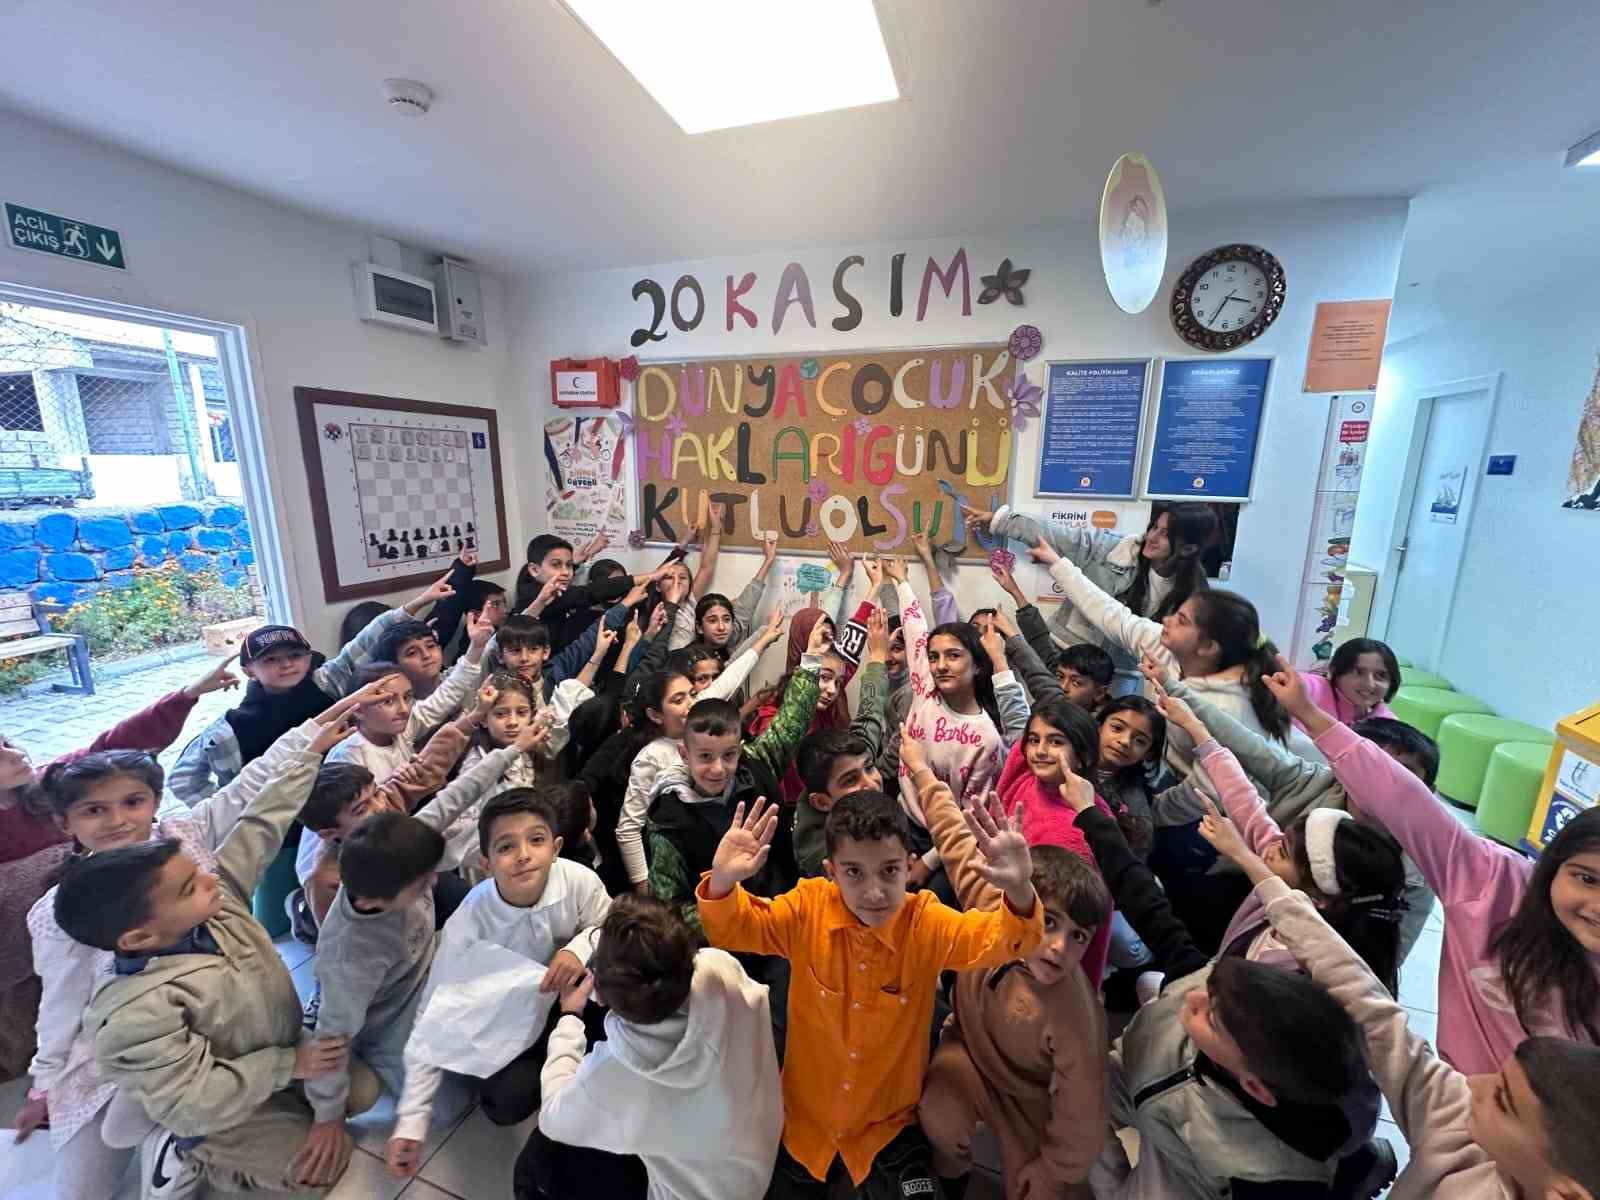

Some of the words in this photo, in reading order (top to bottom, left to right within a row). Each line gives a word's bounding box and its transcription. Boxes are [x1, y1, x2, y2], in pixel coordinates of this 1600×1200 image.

[15, 214, 54, 233] ACİL
[14, 228, 59, 250] ÇIKIŞ
[631, 274, 705, 347] 20
[726, 247, 972, 335] KASIM
[1052, 511, 1086, 521] FİKRİNİ
[934, 716, 982, 747] Barbie
